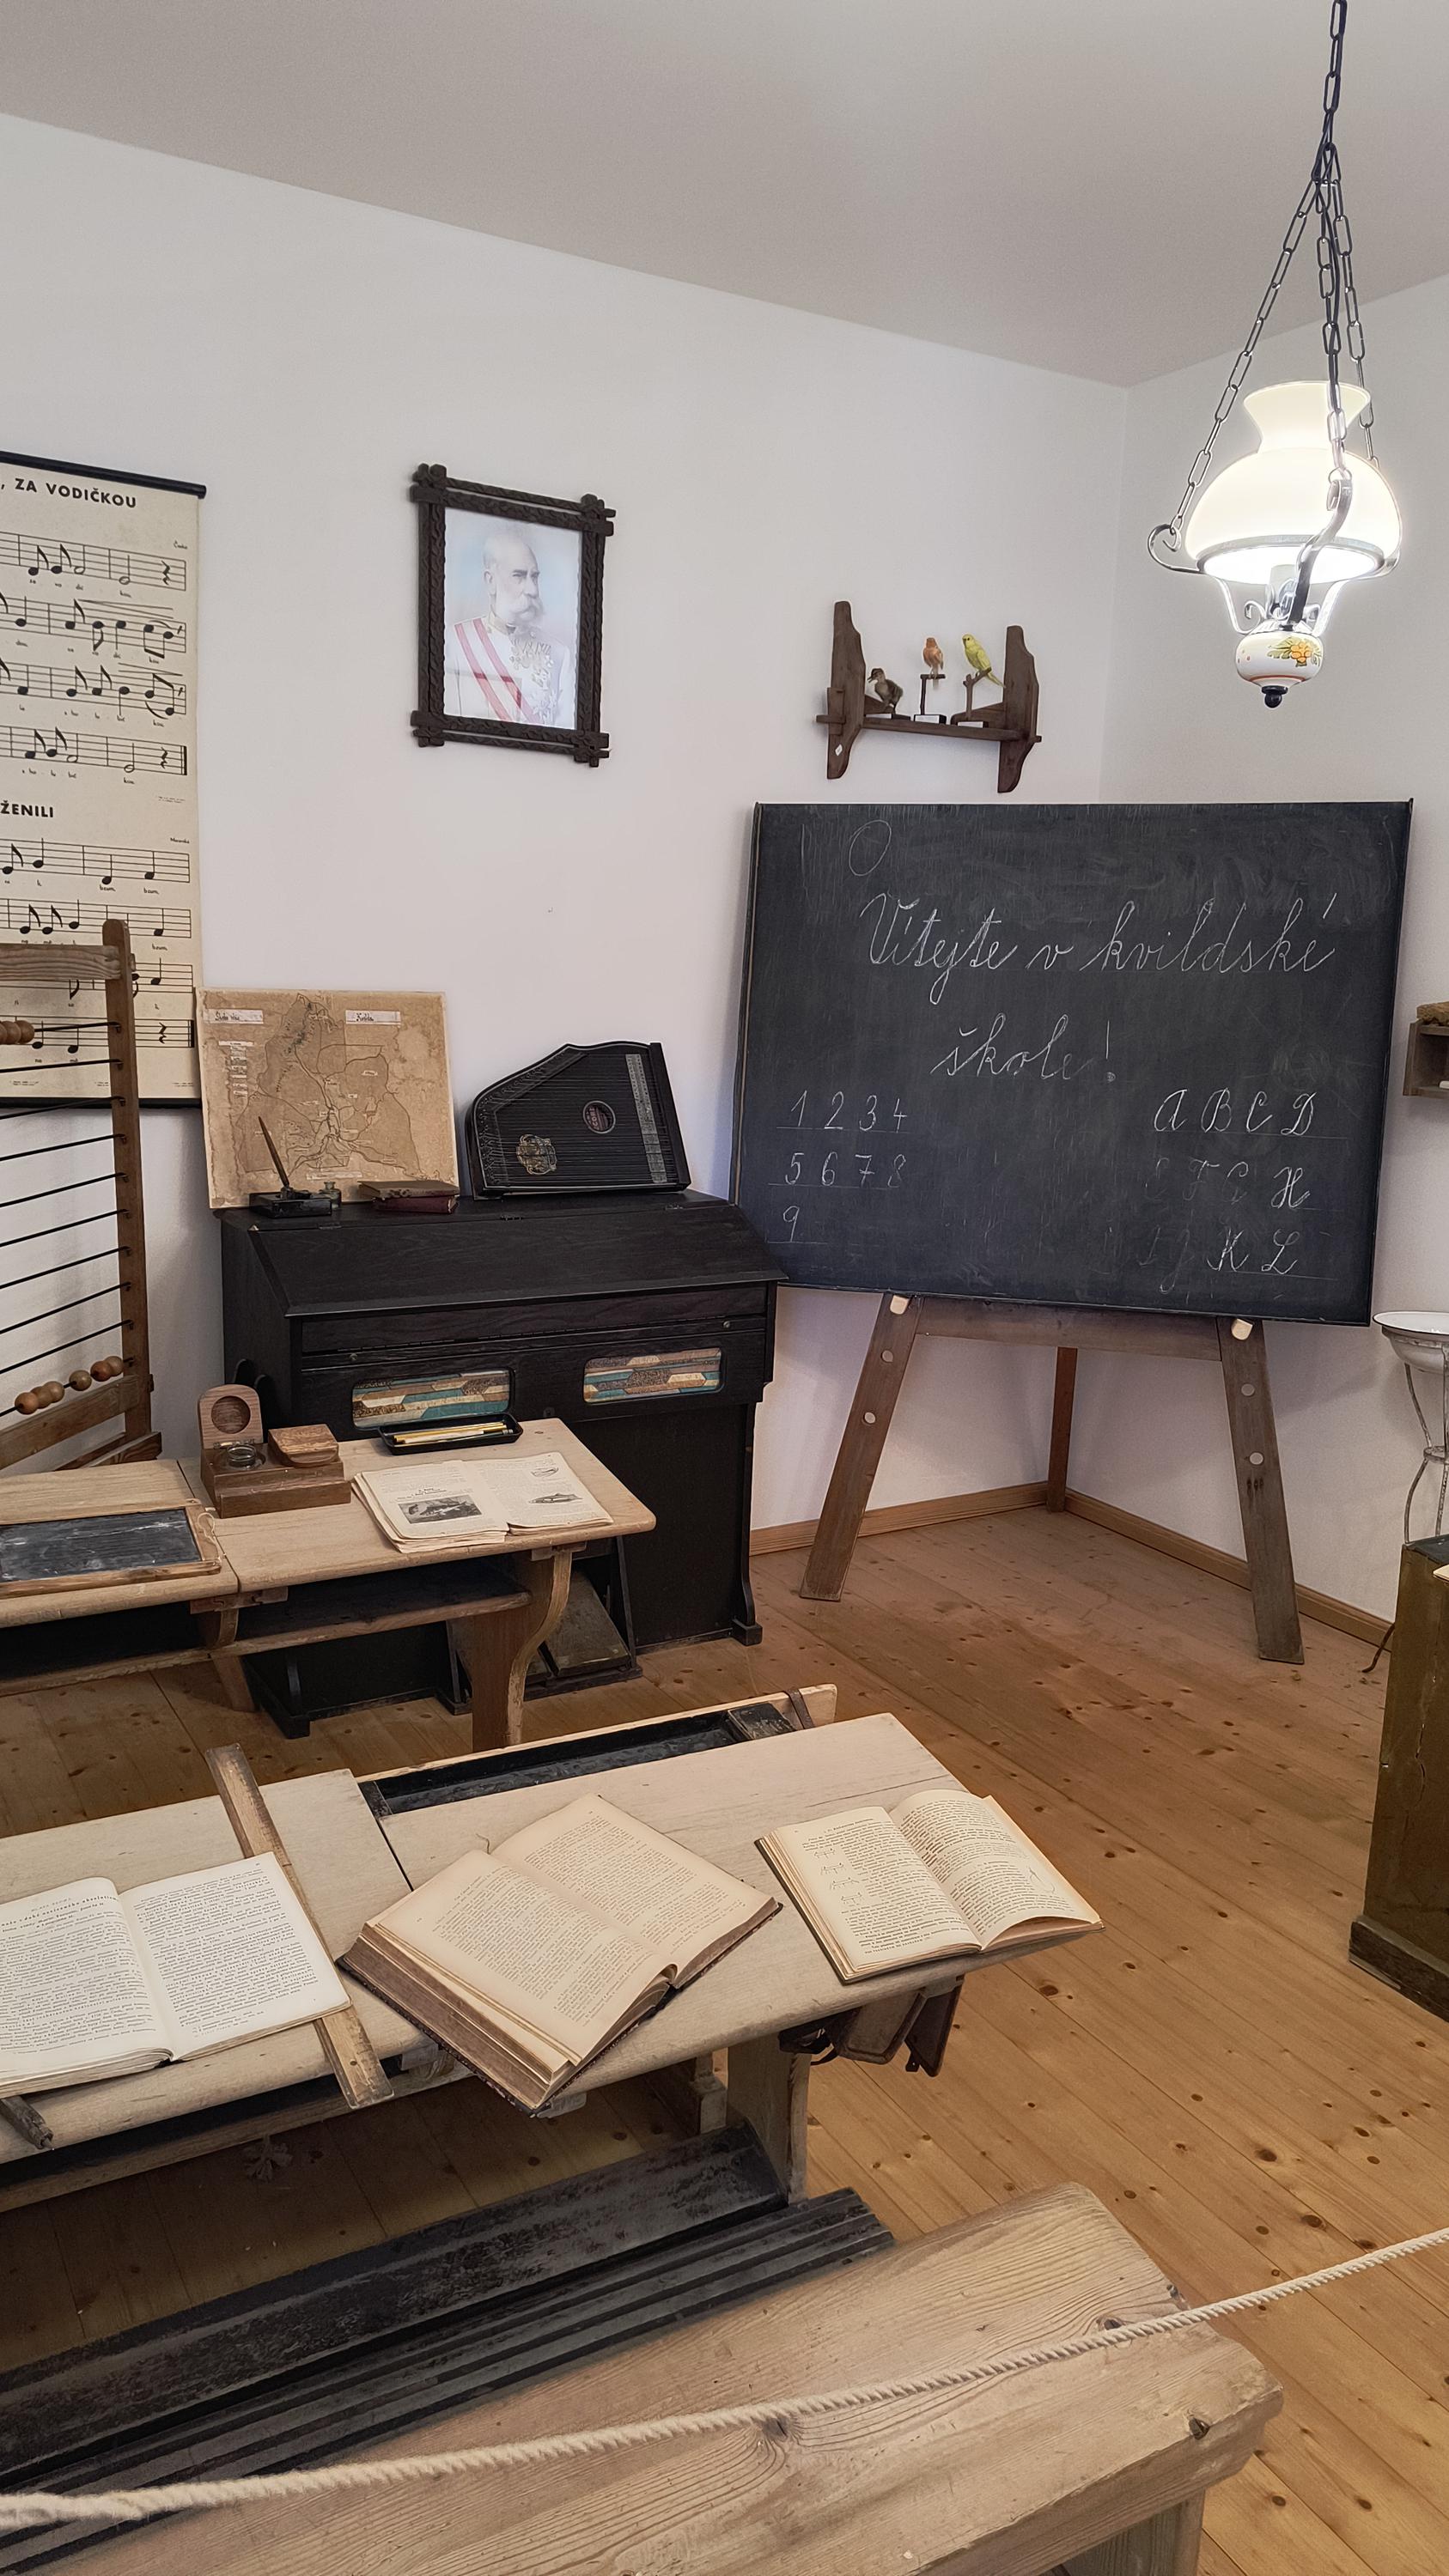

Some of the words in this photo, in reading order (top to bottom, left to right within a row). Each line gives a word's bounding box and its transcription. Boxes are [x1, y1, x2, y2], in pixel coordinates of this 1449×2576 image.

[15, 477, 37, 493] ZA
[46, 483, 137, 507] VODIČKOU
[0, 799, 54, 818] ŽENILI
[859, 892, 1018, 1005] Vítejte
[1026, 945, 1075, 970] v
[1079, 892, 1336, 974] kvildské
[791, 1091, 807, 1127] 1
[824, 1091, 844, 1130] 2
[859, 1095, 878, 1132] 3
[892, 1097, 908, 1133] 4
[1154, 1089, 1188, 1132] A
[1201, 1087, 1233, 1133] B
[1281, 1091, 1318, 1136] D
[785, 1152, 805, 1186] 5
[821, 1151, 838, 1187] 6
[855, 1154, 875, 1188] 7
[887, 1153, 907, 1188] 8
[1270, 1166, 1311, 1209] H
[782, 1206, 801, 1242] 9
[1206, 1228, 1250, 1273] K
[1261, 1228, 1300, 1275] L
